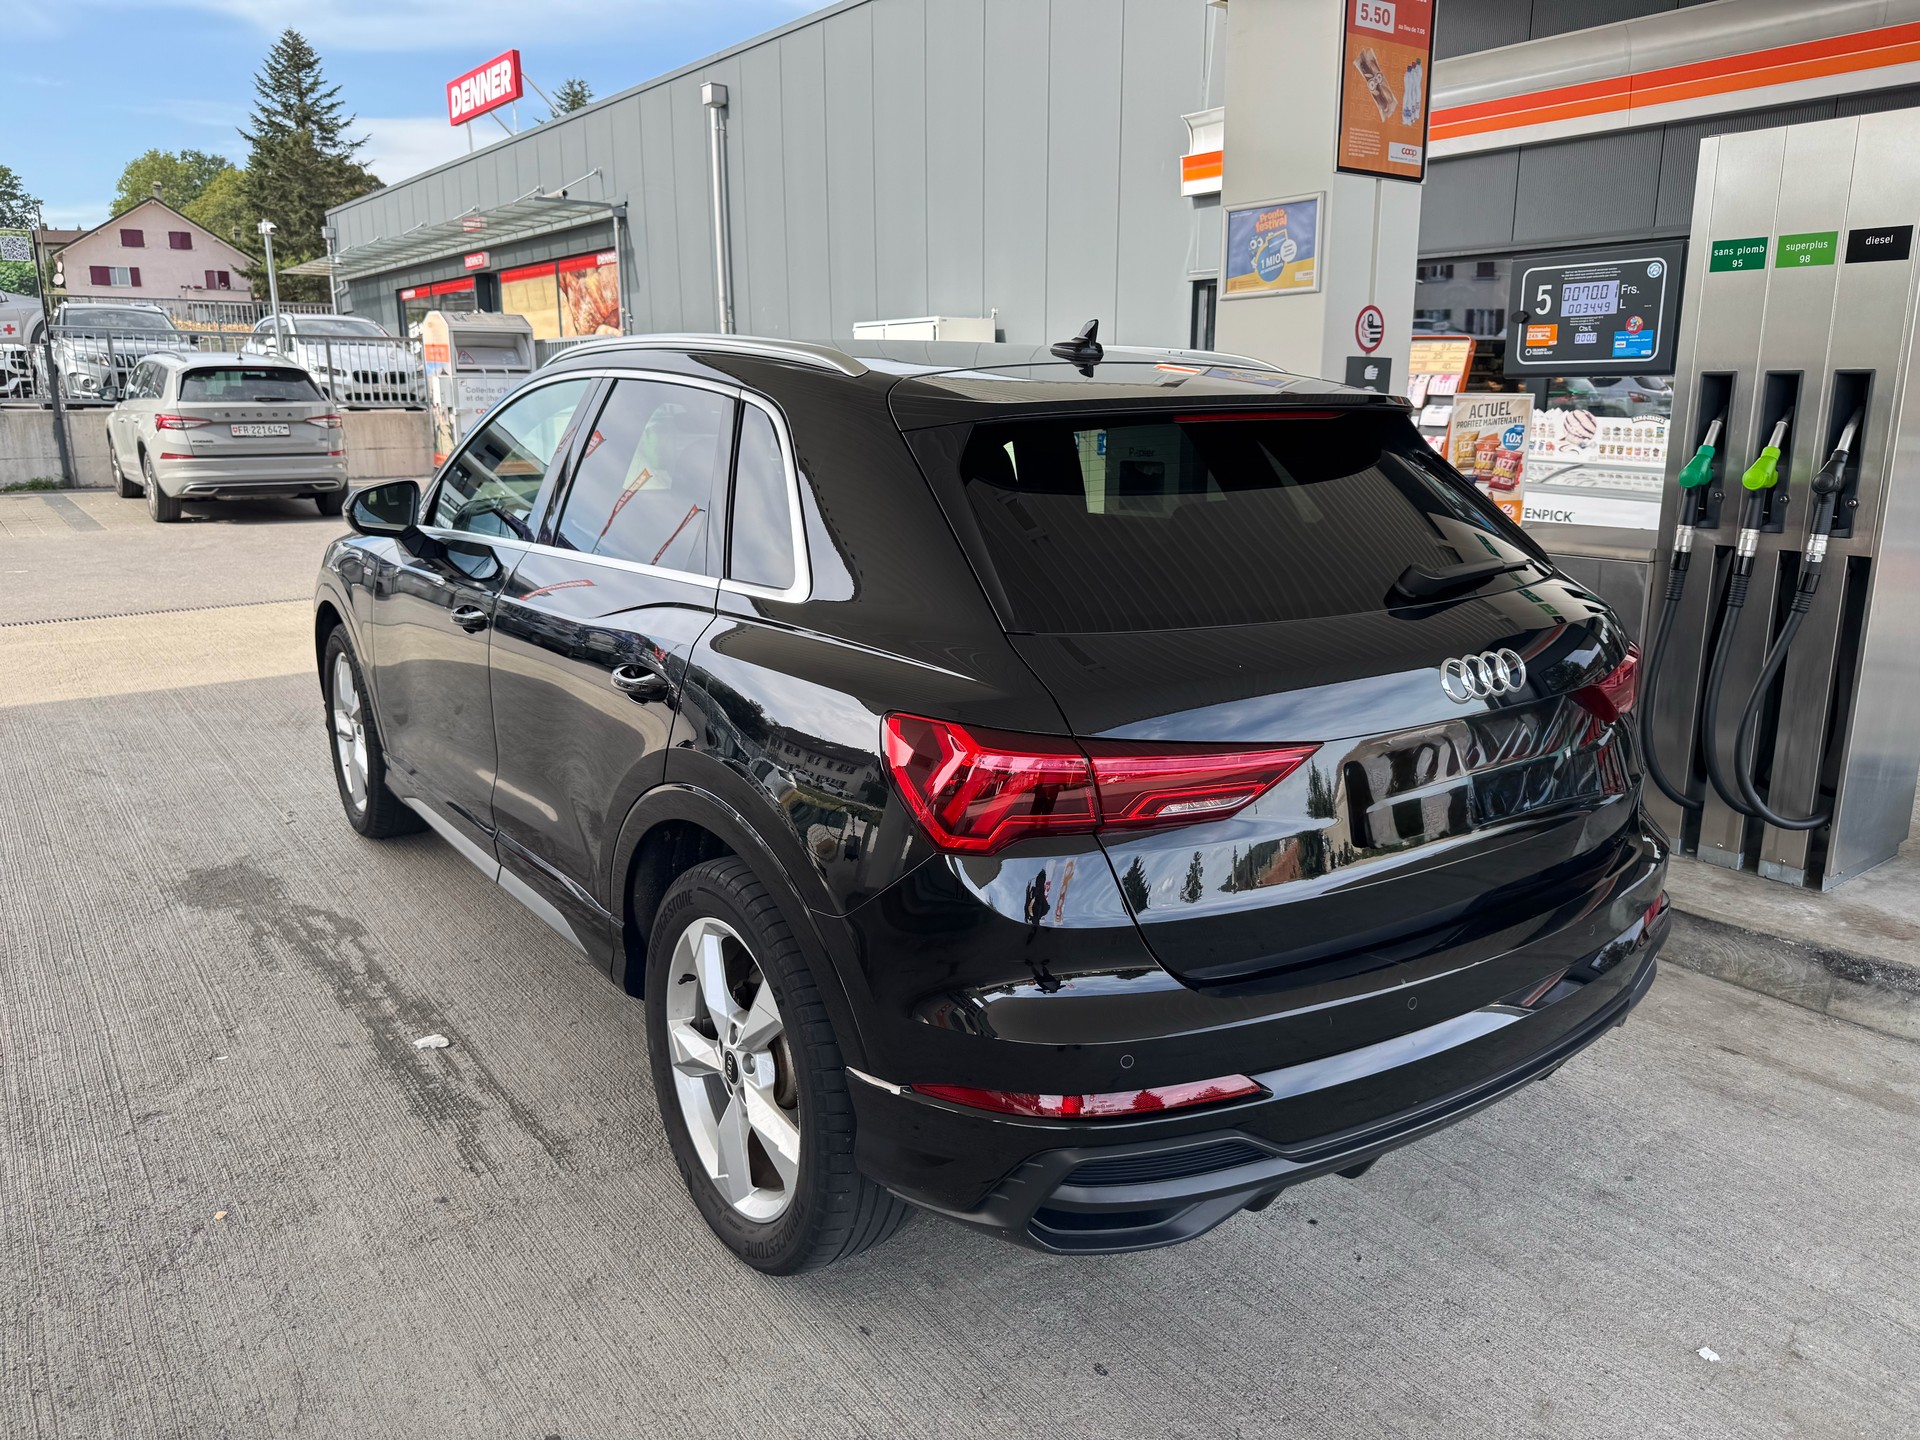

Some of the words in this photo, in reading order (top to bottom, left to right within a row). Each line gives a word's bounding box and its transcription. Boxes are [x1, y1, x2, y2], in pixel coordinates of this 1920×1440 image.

[1360, 3, 1391, 26] 5.50
[451, 60, 512, 119] DENNER
[1401, 147, 1417, 158] coop
[1259, 208, 1285, 222] Pronto
[1255, 214, 1288, 234] festival
[1785, 240, 1828, 252] superplus
[1865, 235, 1894, 246] diesel
[1713, 247, 1733, 256] sans
[1737, 245, 1765, 256] plomb
[1266, 253, 1280, 268] MIO
[1732, 259, 1743, 268] 95
[1799, 255, 1811, 263] 98
[1621, 284, 1640, 295] Frs.
[1535, 284, 1552, 315] 5
[1620, 299, 1627, 309] L
[1568, 302, 1611, 315] 0034.49
[1469, 401, 1511, 419] ACTUEL
[1456, 418, 1482, 429] PROFITEZ
[1483, 416, 1524, 427] MAINTENANT!
[1505, 433, 1522, 444] 10x
